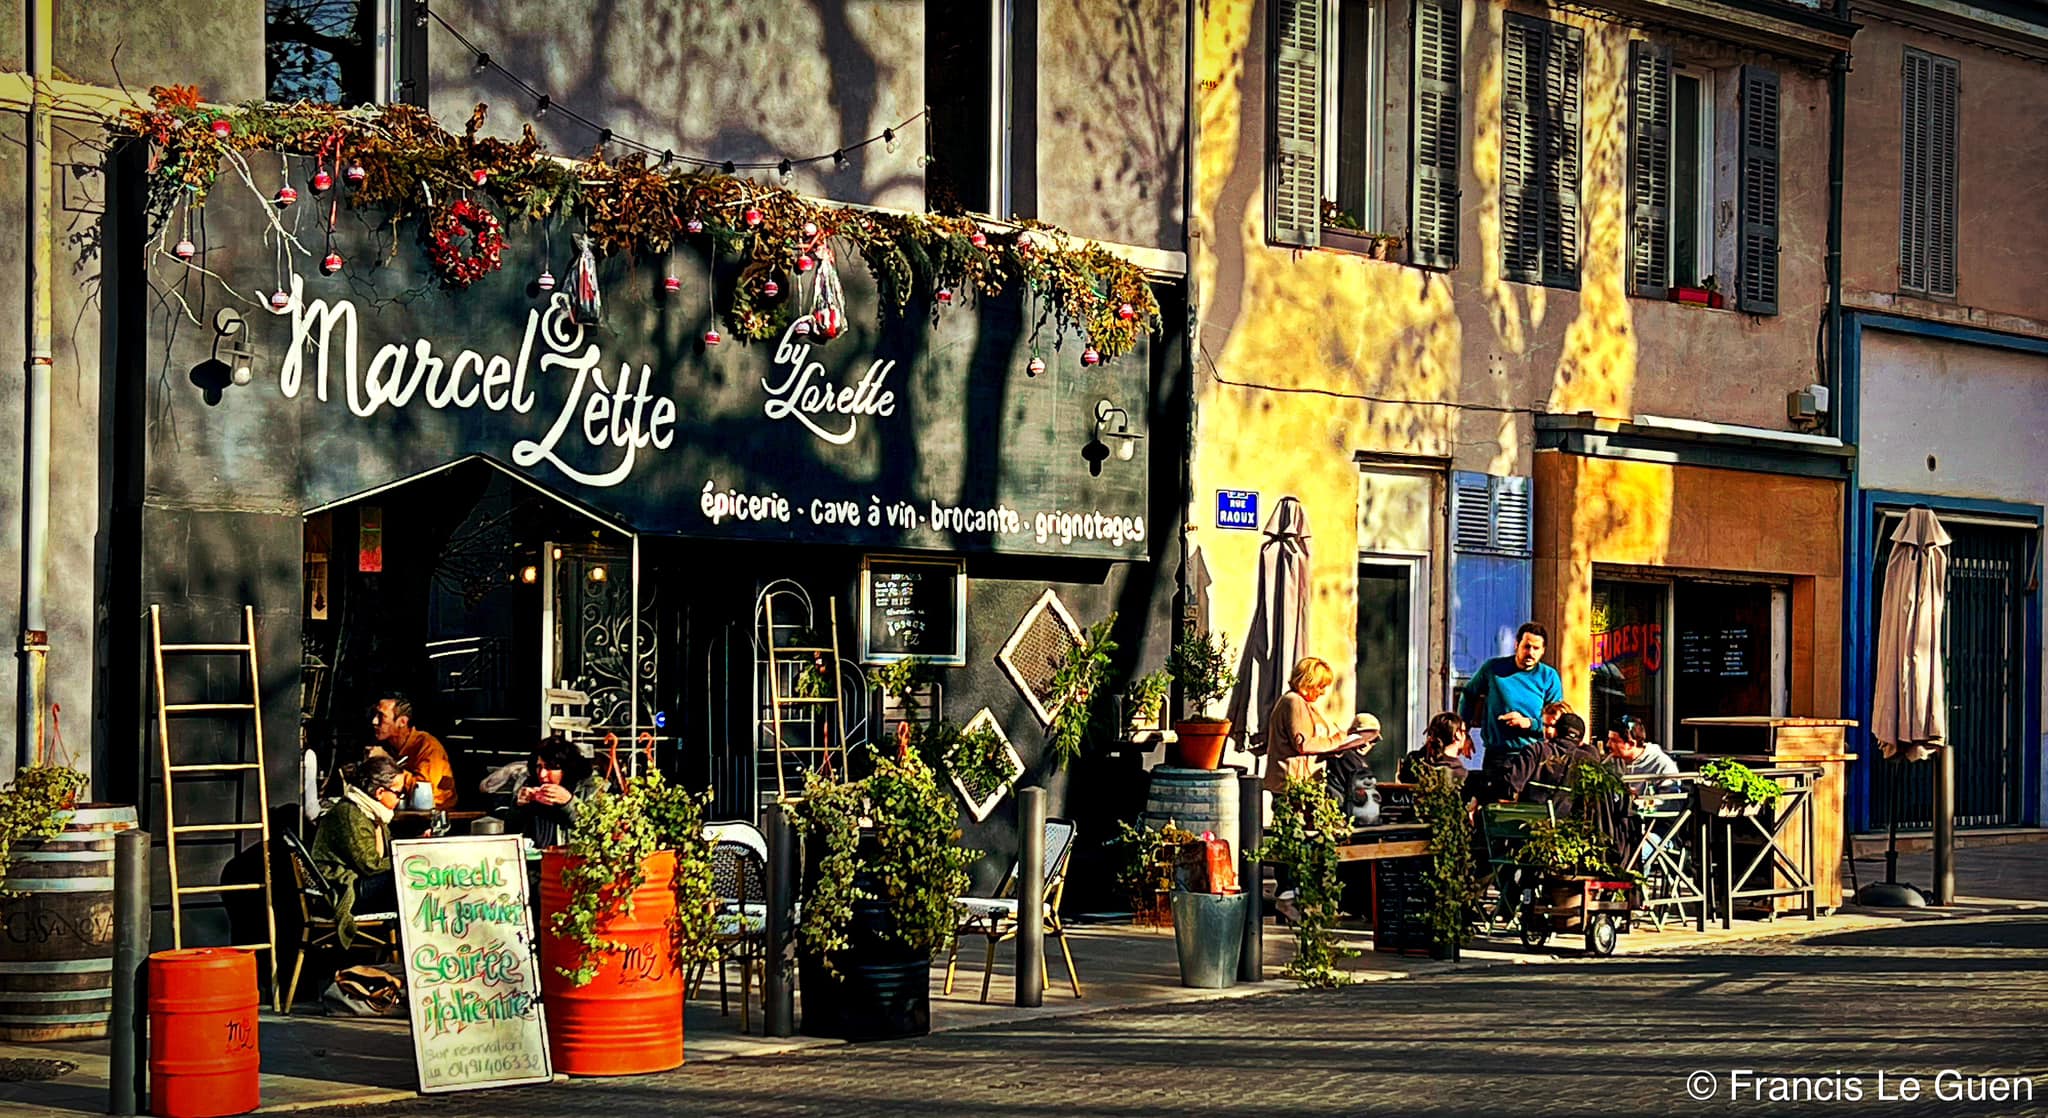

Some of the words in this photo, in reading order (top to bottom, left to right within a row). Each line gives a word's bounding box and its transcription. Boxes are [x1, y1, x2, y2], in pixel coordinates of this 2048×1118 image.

[255, 273, 540, 416] Marcel
[761, 316, 812, 395] by
[764, 359, 896, 444] Lorette
[701, 480, 790, 524] épicerie
[811, 499, 860, 524] cave
[868, 496, 880, 526] à
[886, 501, 916, 529] vin
[931, 501, 1019, 534] brocante
[1034, 513, 1145, 547] grignotages
[1220, 510, 1255, 524] RAOUX
[1230, 499, 1246, 508] RUE
[1590, 624, 1639, 666] EURES
[402, 854, 507, 892] Samedi
[412, 892, 447, 934] 14
[412, 940, 525, 988] Soirée
